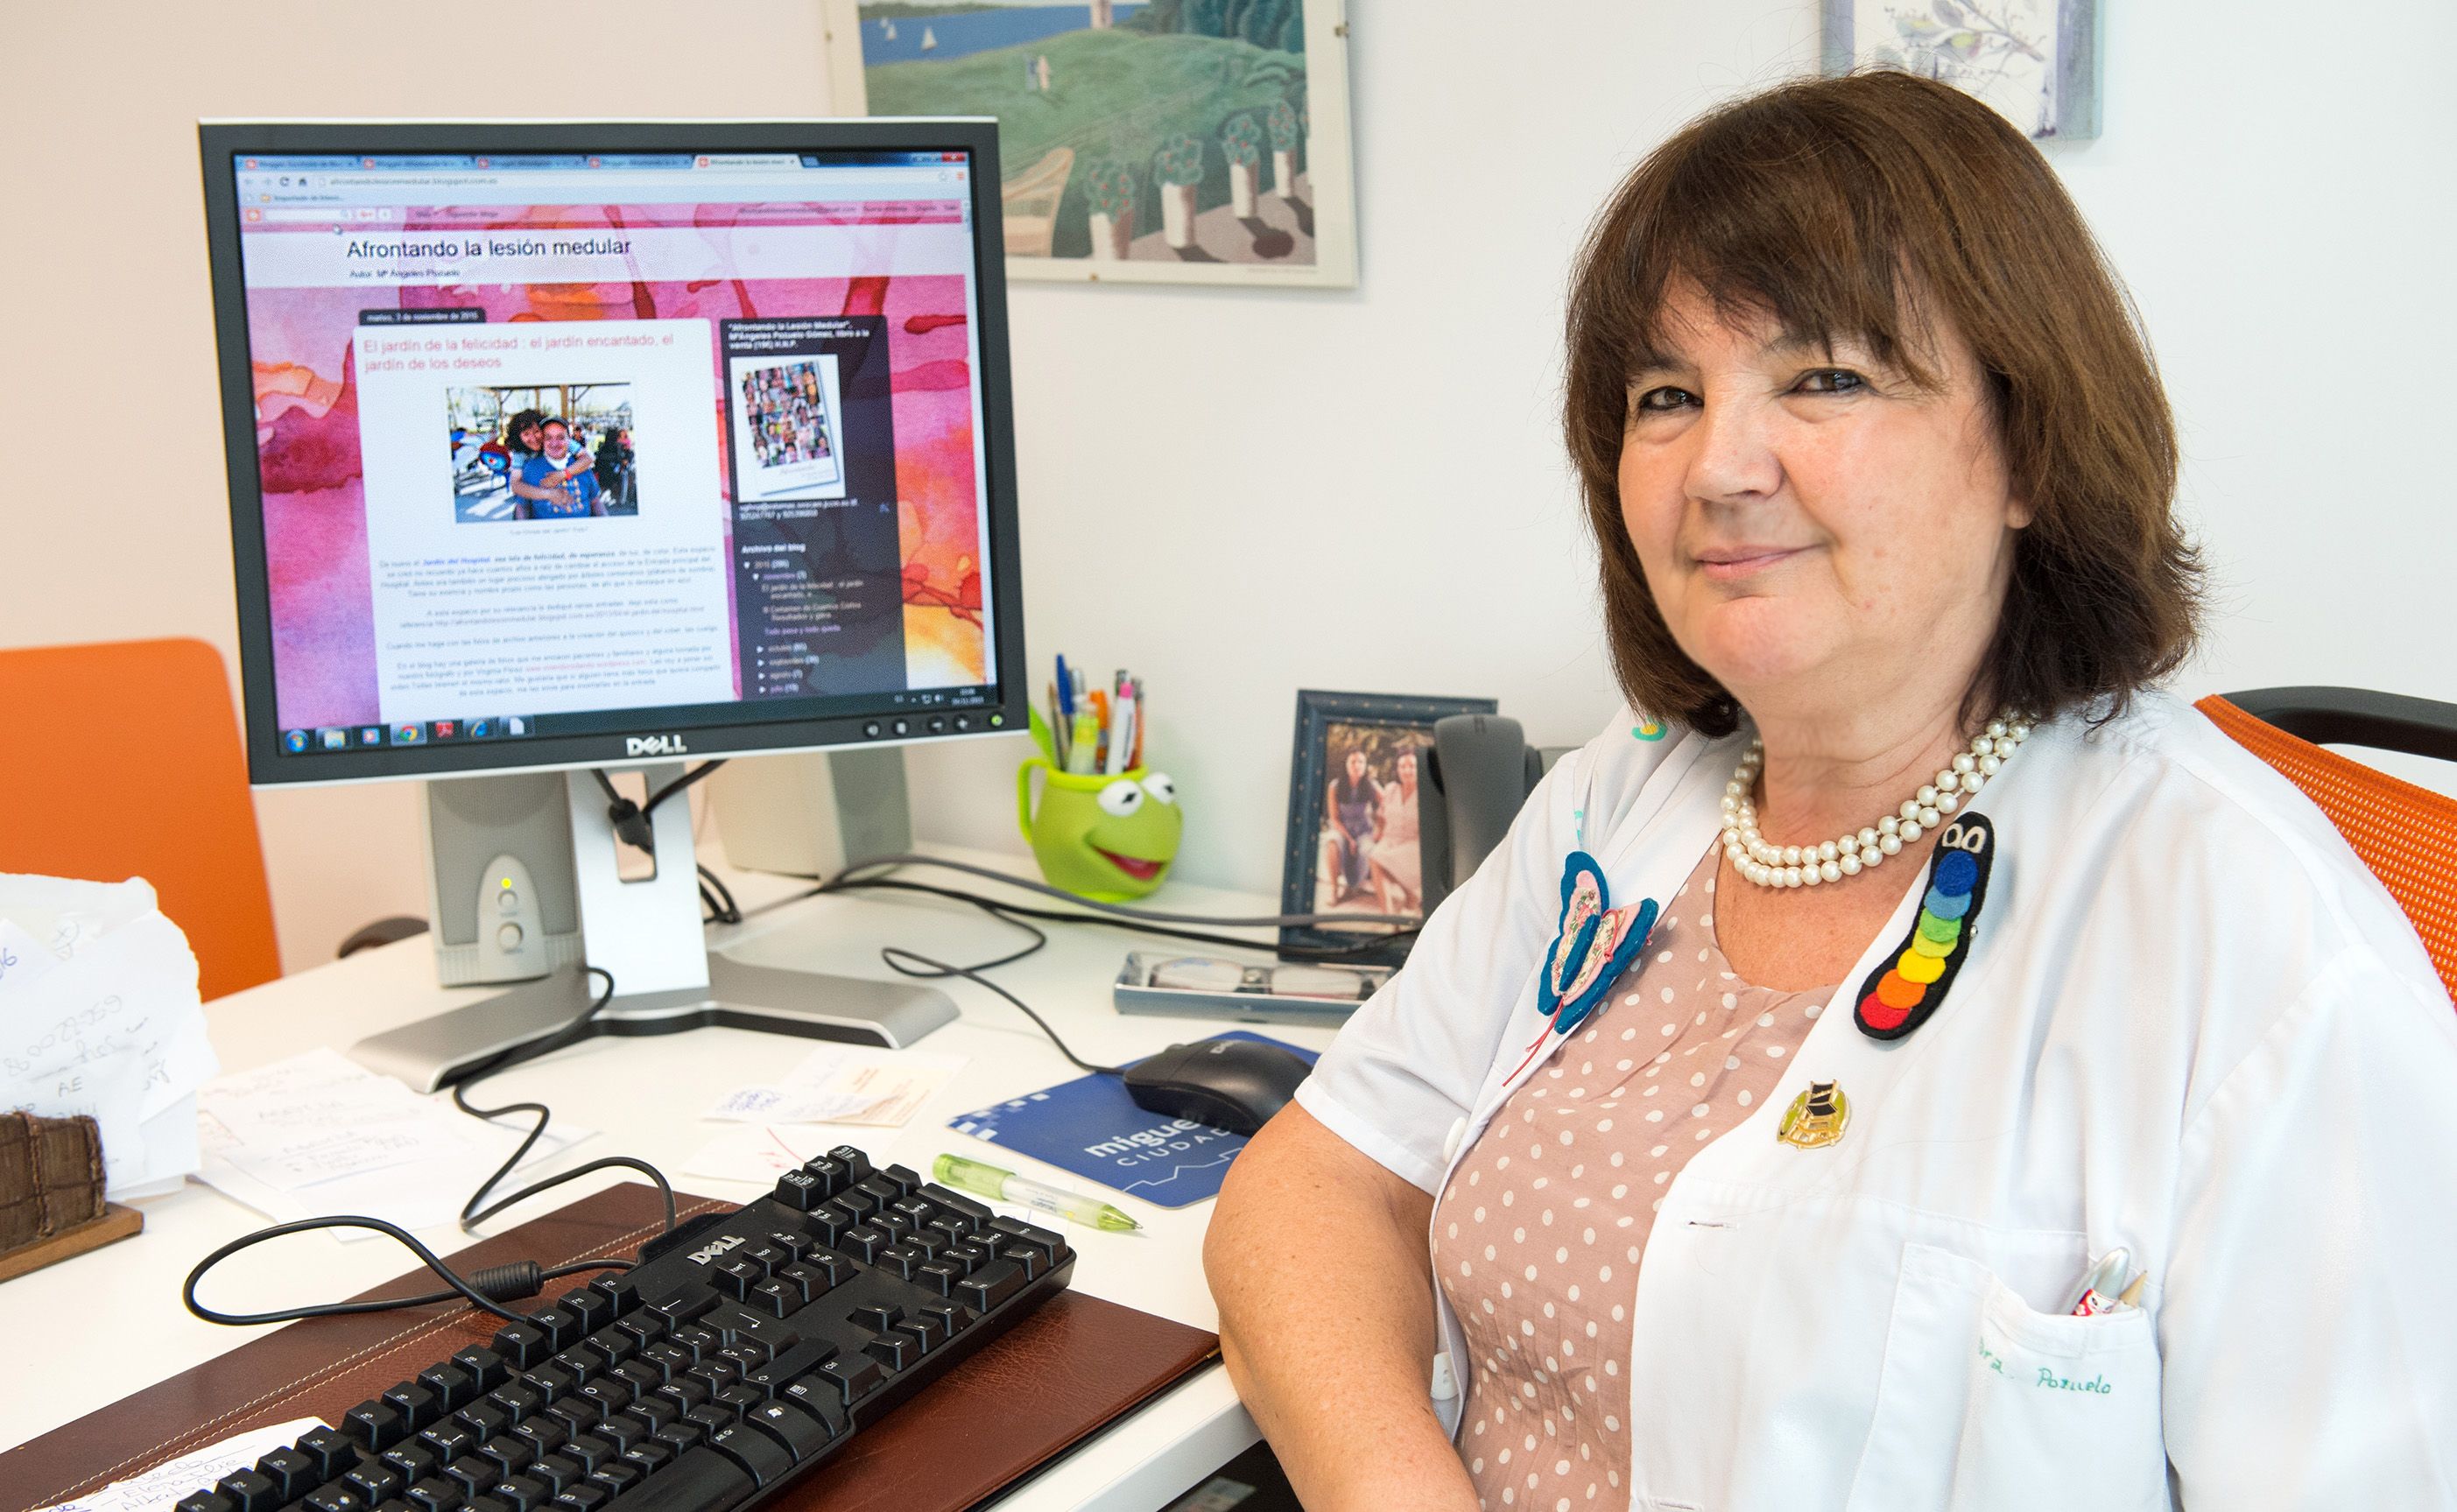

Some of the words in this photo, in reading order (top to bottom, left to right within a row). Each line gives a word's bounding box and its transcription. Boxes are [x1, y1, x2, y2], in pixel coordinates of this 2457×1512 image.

[347, 239, 459, 258] Afrontando
[465, 238, 482, 257] la
[489, 237, 546, 257] lesión
[553, 236, 632, 256] medular
[363, 339, 377, 353] El
[381, 338, 421, 355] jardín
[425, 338, 441, 351] de
[445, 337, 458, 350] la
[461, 335, 518, 350] felicidad
[530, 335, 542, 348] el
[546, 334, 584, 350] jardín
[588, 334, 658, 348] encantado,
[662, 333, 674, 346] el
[364, 357, 404, 373] jardín
[408, 357, 426, 370] de
[429, 356, 449, 369] los
[453, 356, 502, 369] deseos
[742, 543, 773, 554] Archivo
[773, 543, 787, 553] del
[787, 542, 806, 554] blog
[626, 735, 687, 756] DELL
[1083, 1119, 1200, 1157] migue
[686, 1234, 746, 1265] DELL
[729, 1262, 746, 1274] Insert
[601, 1279, 617, 1289] F12
[571, 1297, 585, 1305] F11
[539, 1314, 555, 1324] F10
[508, 1332, 522, 1340] F9
[464, 1355, 478, 1364] F8
[432, 1373, 445, 1382] F7
[613, 1368, 626, 1377] P
[2037, 1367, 2112, 1395] Pozuelo
[583, 1386, 599, 1396] O
[395, 1393, 410, 1402] F6
[359, 1411, 375, 1421] F5
[517, 1424, 534, 1435] U
[598, 1423, 616, 1432] K
[482, 1444, 498, 1454] Y
[569, 1443, 582, 1452] J
[624, 1450, 644, 1459] M
[272, 1458, 288, 1468] F3
[532, 1462, 551, 1473] H
[447, 1465, 463, 1474] T
[592, 1471, 610, 1480] N
[231, 1480, 248, 1489] F2
[499, 1483, 517, 1494] G
[410, 1487, 430, 1497] R
[558, 1493, 577, 1502] B
